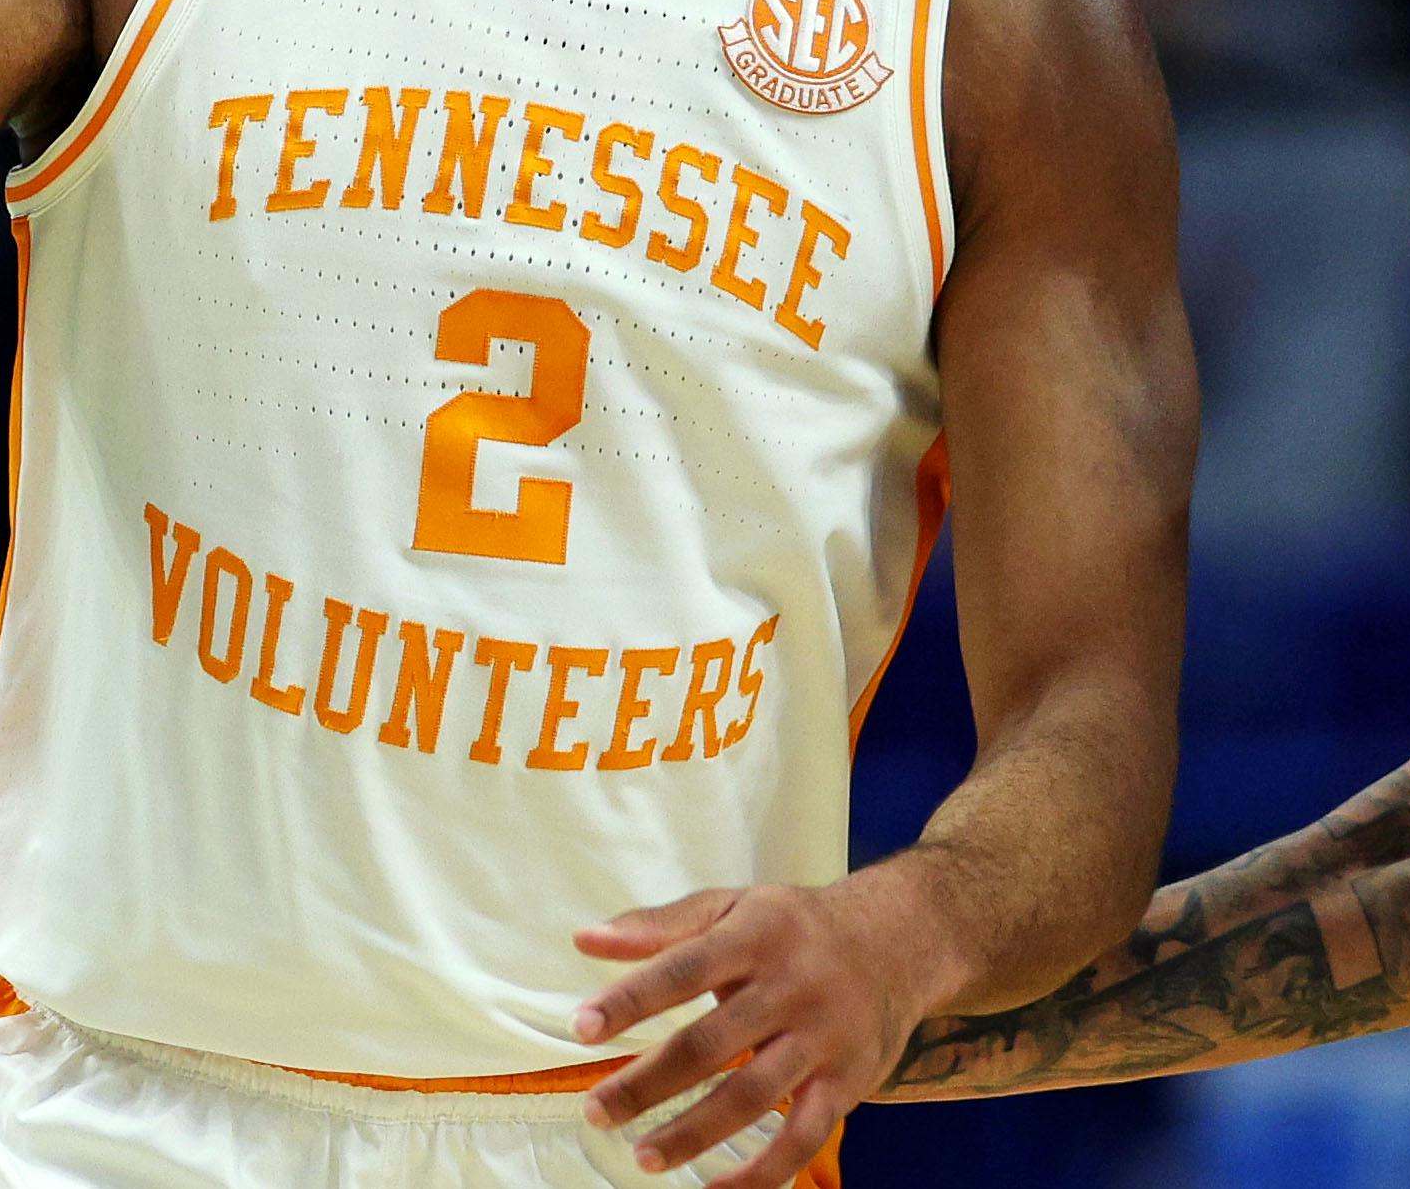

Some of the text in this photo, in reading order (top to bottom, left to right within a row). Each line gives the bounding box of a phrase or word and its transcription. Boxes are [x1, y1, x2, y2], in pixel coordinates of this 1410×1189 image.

[735, 51, 865, 109] GRADUATE
[207, 86, 852, 351] TENNESSEE
[413, 288, 591, 565] 2
[143, 501, 781, 771] VOLUNTEERS
